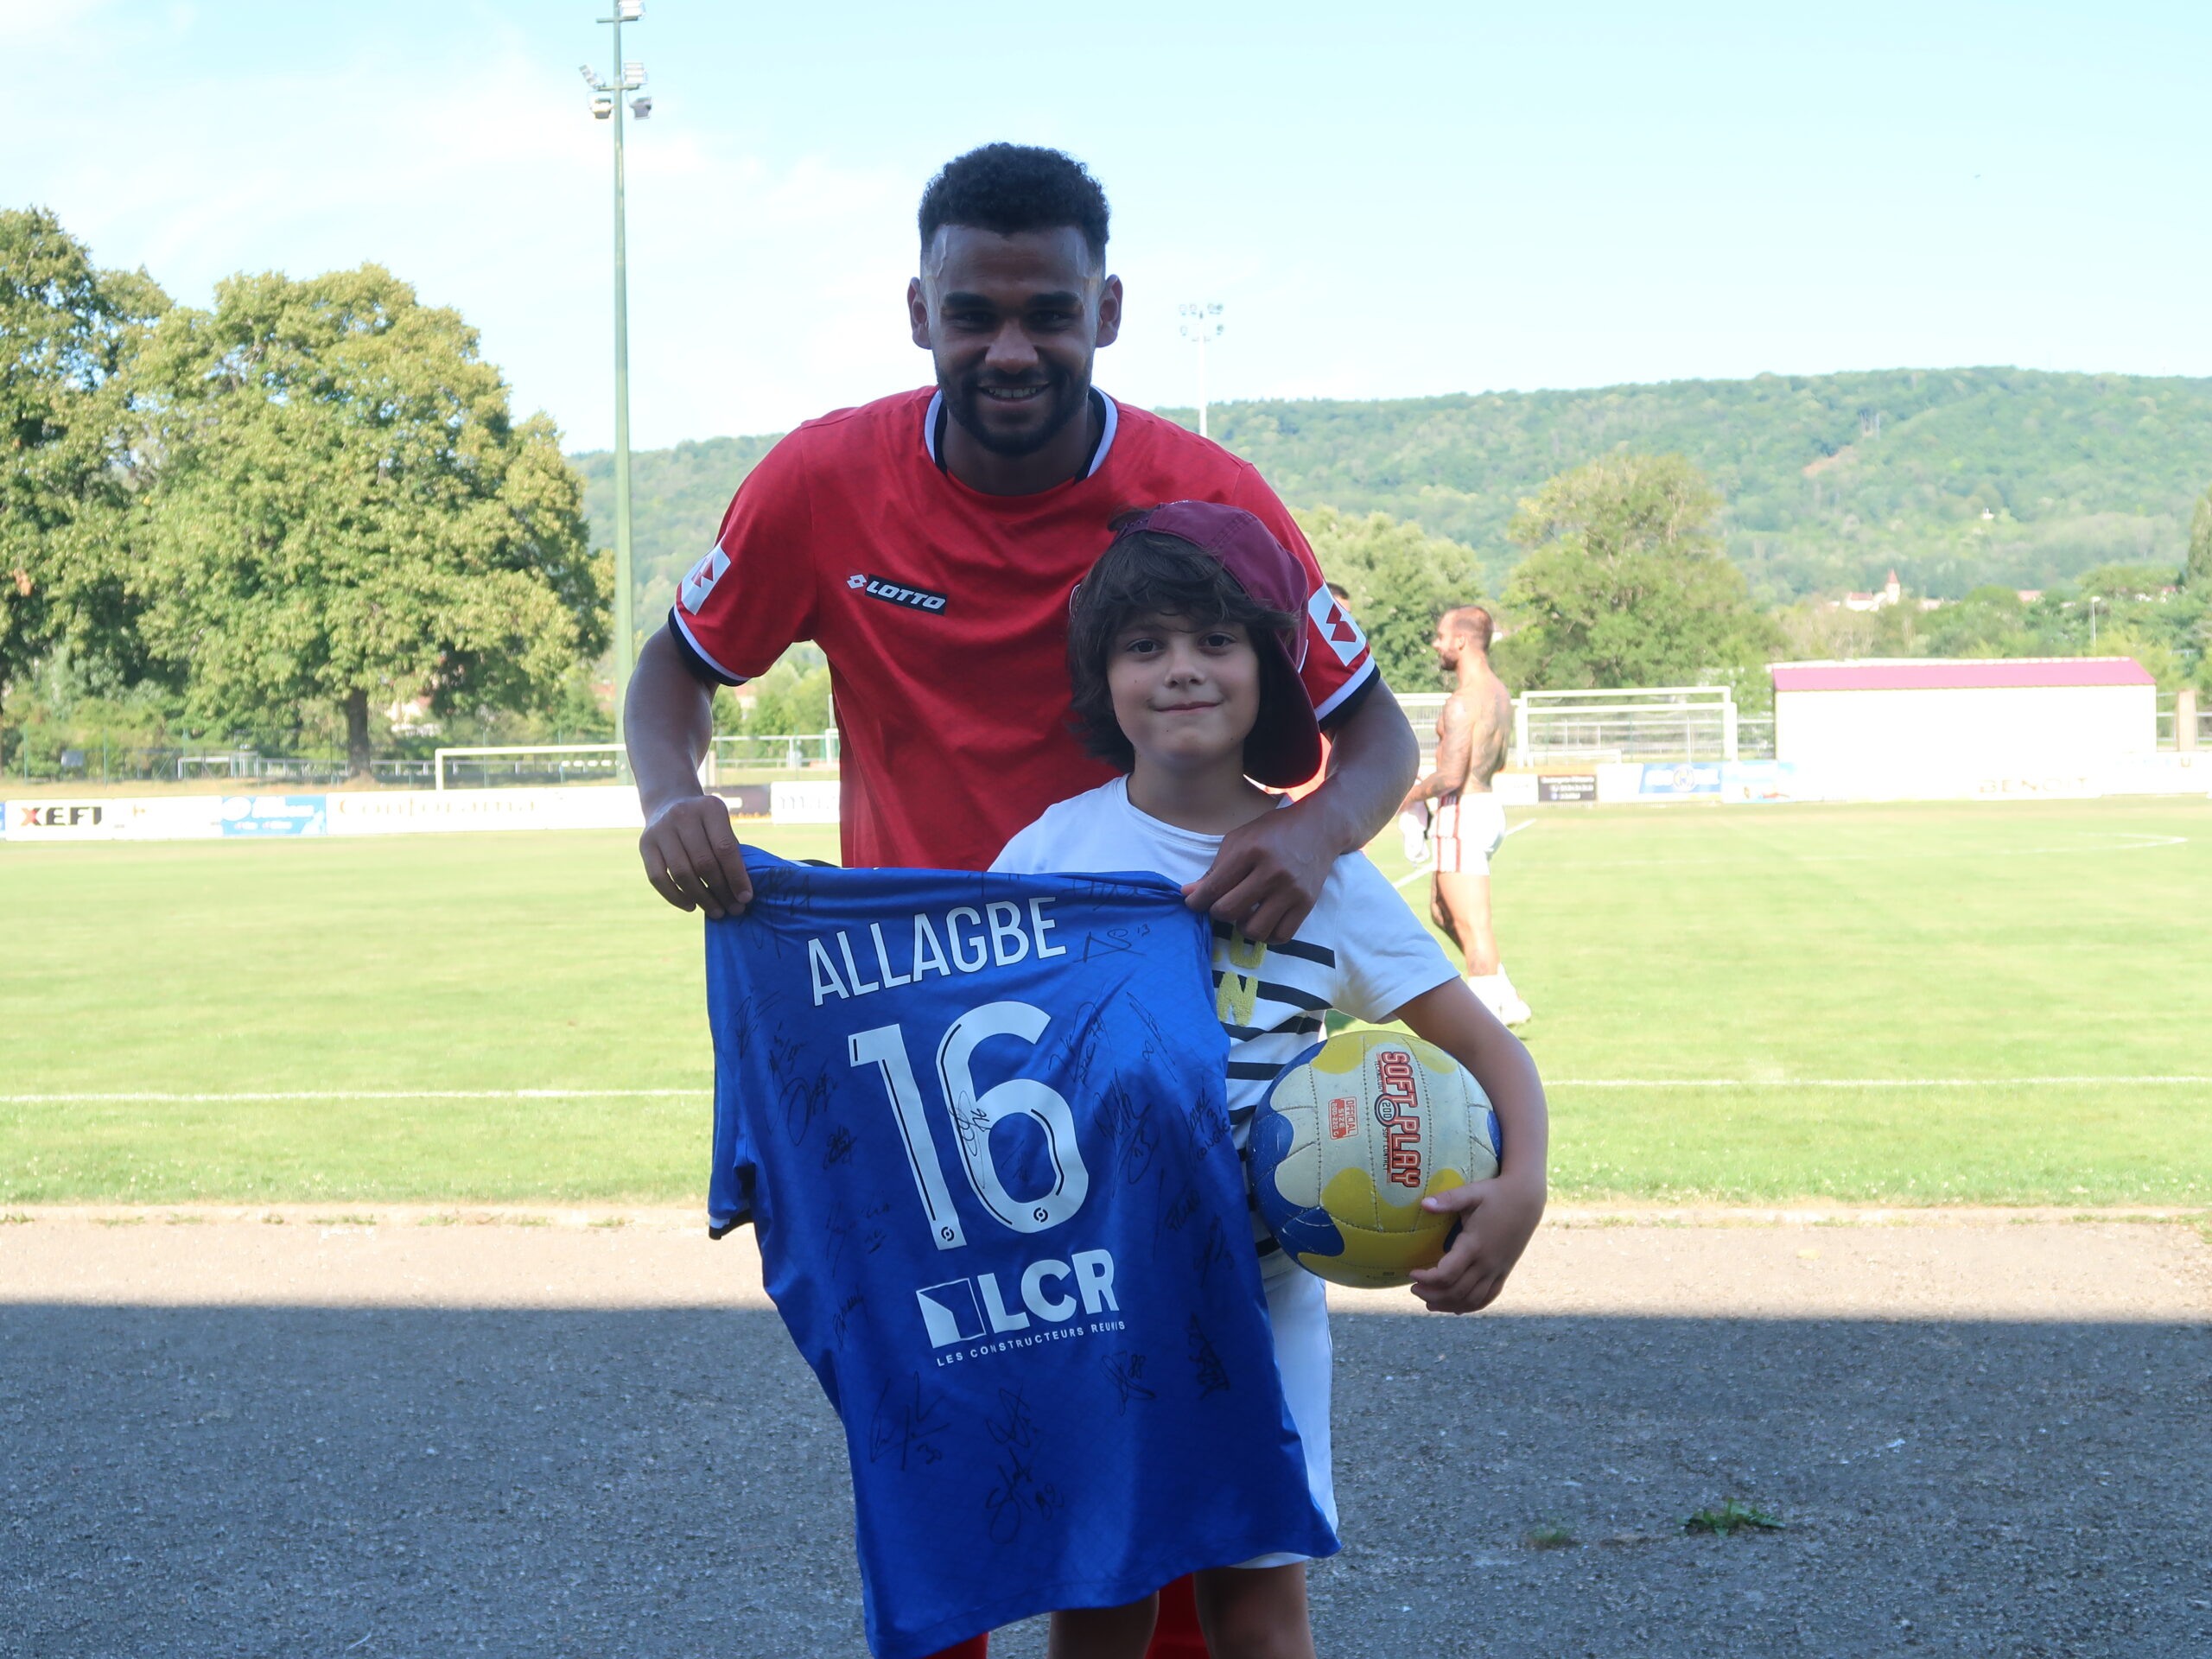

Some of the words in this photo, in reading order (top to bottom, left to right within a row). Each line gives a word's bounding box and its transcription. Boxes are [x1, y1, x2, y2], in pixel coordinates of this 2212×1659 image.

[866, 580, 946, 609] LOTTO
[20, 805, 103, 827] XEFI
[807, 896, 1067, 1007] ALLAGBE
[1382, 1051, 1419, 1108] SOFT
[848, 1000, 1090, 1251] 16
[1345, 1099, 1357, 1135] OFFICIAL
[1382, 1102, 1392, 1119] 200
[1391, 1116, 1422, 1188] PLAY
[977, 1249, 1120, 1334] LCR
[937, 1351, 963, 1367] LES
[969, 1326, 1084, 1358] CONSTRUCTEURS
